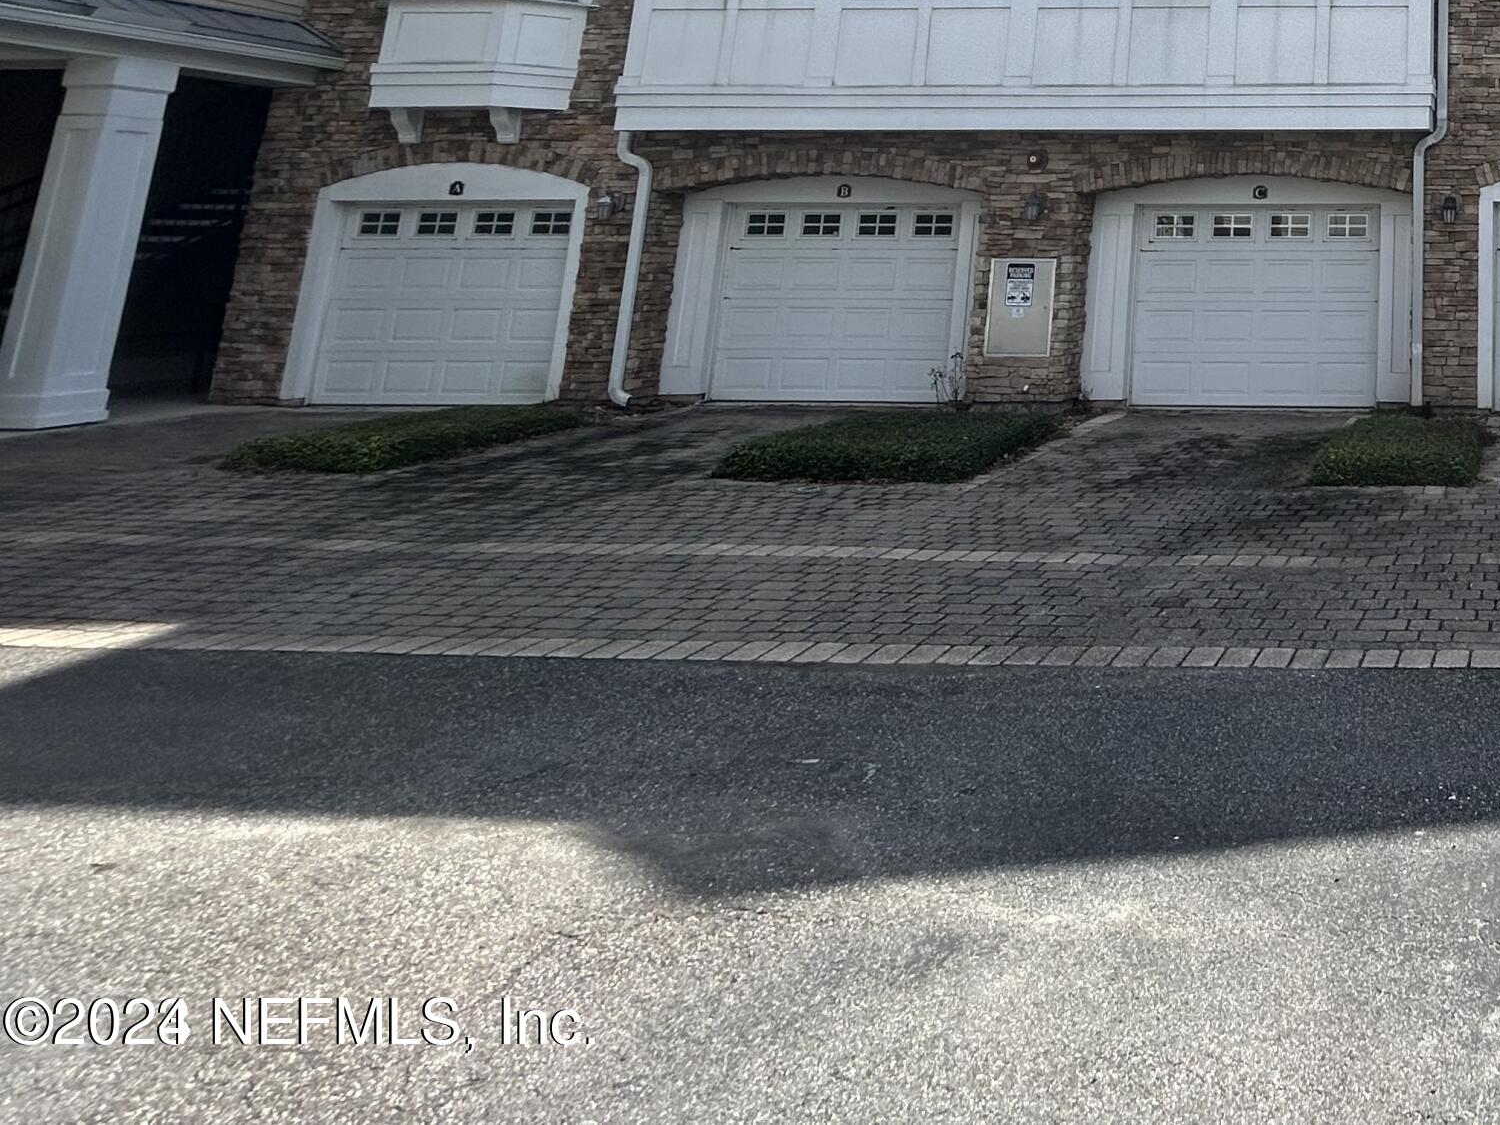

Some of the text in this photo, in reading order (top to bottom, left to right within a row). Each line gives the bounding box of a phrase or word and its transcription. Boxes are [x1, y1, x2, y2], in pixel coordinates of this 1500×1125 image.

[451, 183, 462, 194] A
[840, 186, 849, 196] B
[1255, 187, 1265, 198] C
